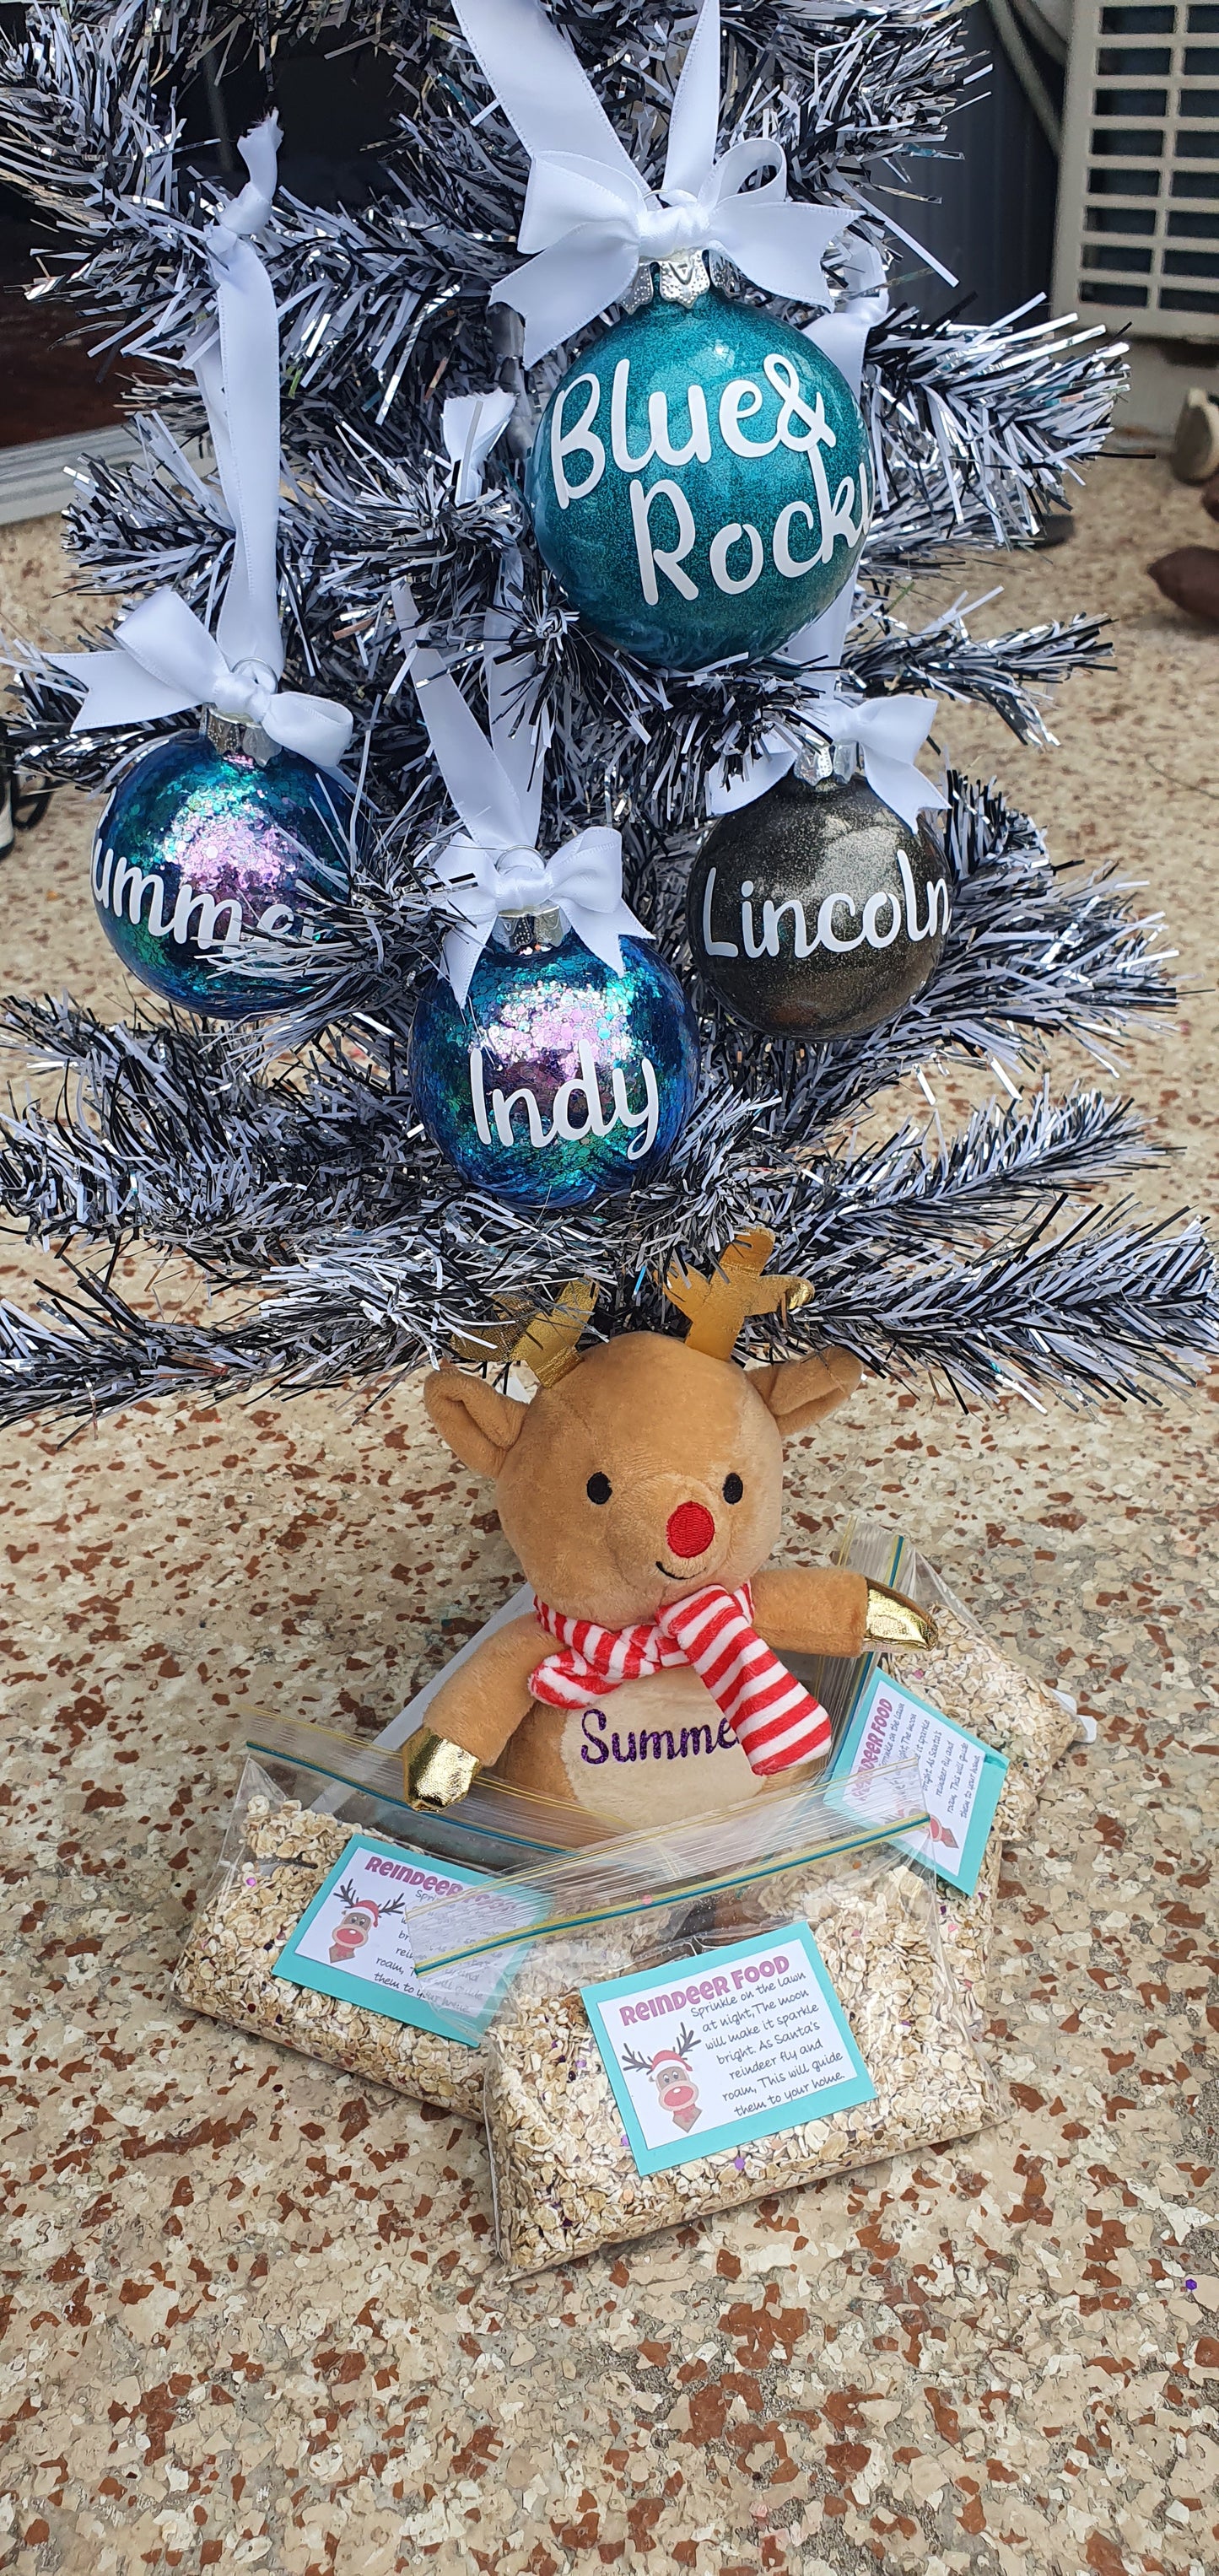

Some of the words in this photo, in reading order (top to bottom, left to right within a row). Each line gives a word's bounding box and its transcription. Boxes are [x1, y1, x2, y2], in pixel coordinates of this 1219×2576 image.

[91, 787, 315, 960] umme
[703, 849, 952, 958] Lincoln
[470, 1039, 659, 1161] Indy
[871, 1698, 893, 1737] FOOD
[893, 1702, 905, 1720] lawn
[581, 1708, 741, 1765] Summe
[890, 1720, 900, 1732] the
[919, 1719, 930, 1744] sparkle
[878, 1742, 893, 1767] prinkle
[929, 1730, 942, 1758] Santa's
[946, 1739, 955, 1756] and
[959, 1742, 969, 1762] guide
[926, 1757, 936, 1768] As
[955, 1761, 964, 1776] will
[950, 1775, 961, 1791] This
[964, 1790, 973, 1799] to
[968, 1774, 976, 1791] your
[960, 1801, 970, 1819] them
[375, 1957, 404, 1975] roam,
[374, 1971, 399, 1989] them
[403, 1982, 414, 1993] to
[619, 1976, 731, 2026] REINDEER
[731, 1956, 789, 1990] FOOD
[691, 1997, 737, 2018] Sprinkle
[741, 1991, 754, 2001] on
[756, 1982, 776, 1994] the
[777, 1972, 806, 1987] lawn
[703, 2020, 718, 2032] at
[778, 1990, 809, 2006] moon
[705, 2036, 726, 2050] will
[728, 2025, 761, 2042] make
[762, 2018, 774, 2030] it
[776, 2004, 819, 2027] sparkle
[716, 2045, 757, 2065] bright.
[759, 2040, 774, 2051] As
[774, 2021, 821, 2044] Santa's
[729, 2056, 777, 2080] reindeer
[780, 2050, 798, 2061] fly
[800, 2038, 823, 2055] and
[722, 2086, 757, 2102] roam,
[757, 2072, 786, 2088] This
[788, 2063, 810, 2078] will
[812, 2051, 844, 2072] guide
[734, 2101, 767, 2116] them
[767, 2094, 782, 2104] to
[784, 2083, 810, 2101] your
[812, 2072, 845, 2088] home.
